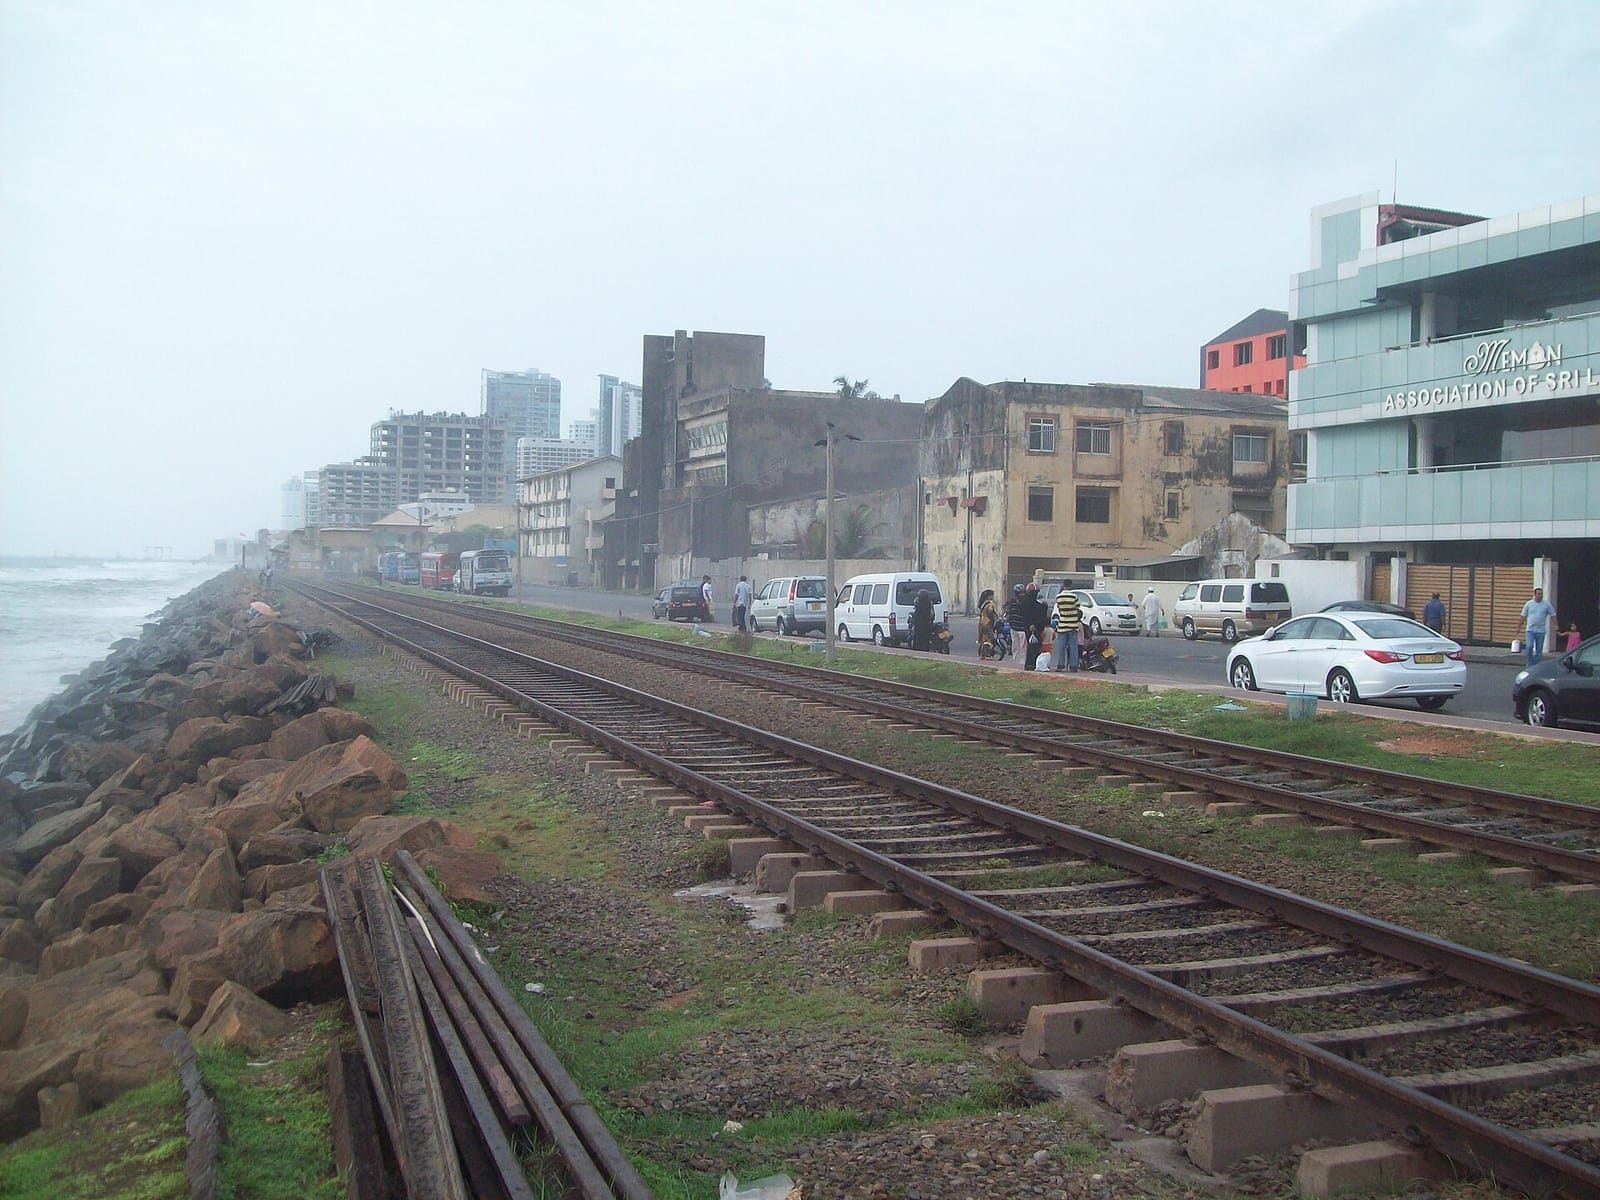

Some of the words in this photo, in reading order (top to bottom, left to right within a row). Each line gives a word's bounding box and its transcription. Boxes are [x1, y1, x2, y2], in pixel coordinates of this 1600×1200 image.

[1385, 379, 1507, 410] ASSOCIATION
[1514, 375, 1539, 395] OF
[1546, 368, 1580, 391] SRI
